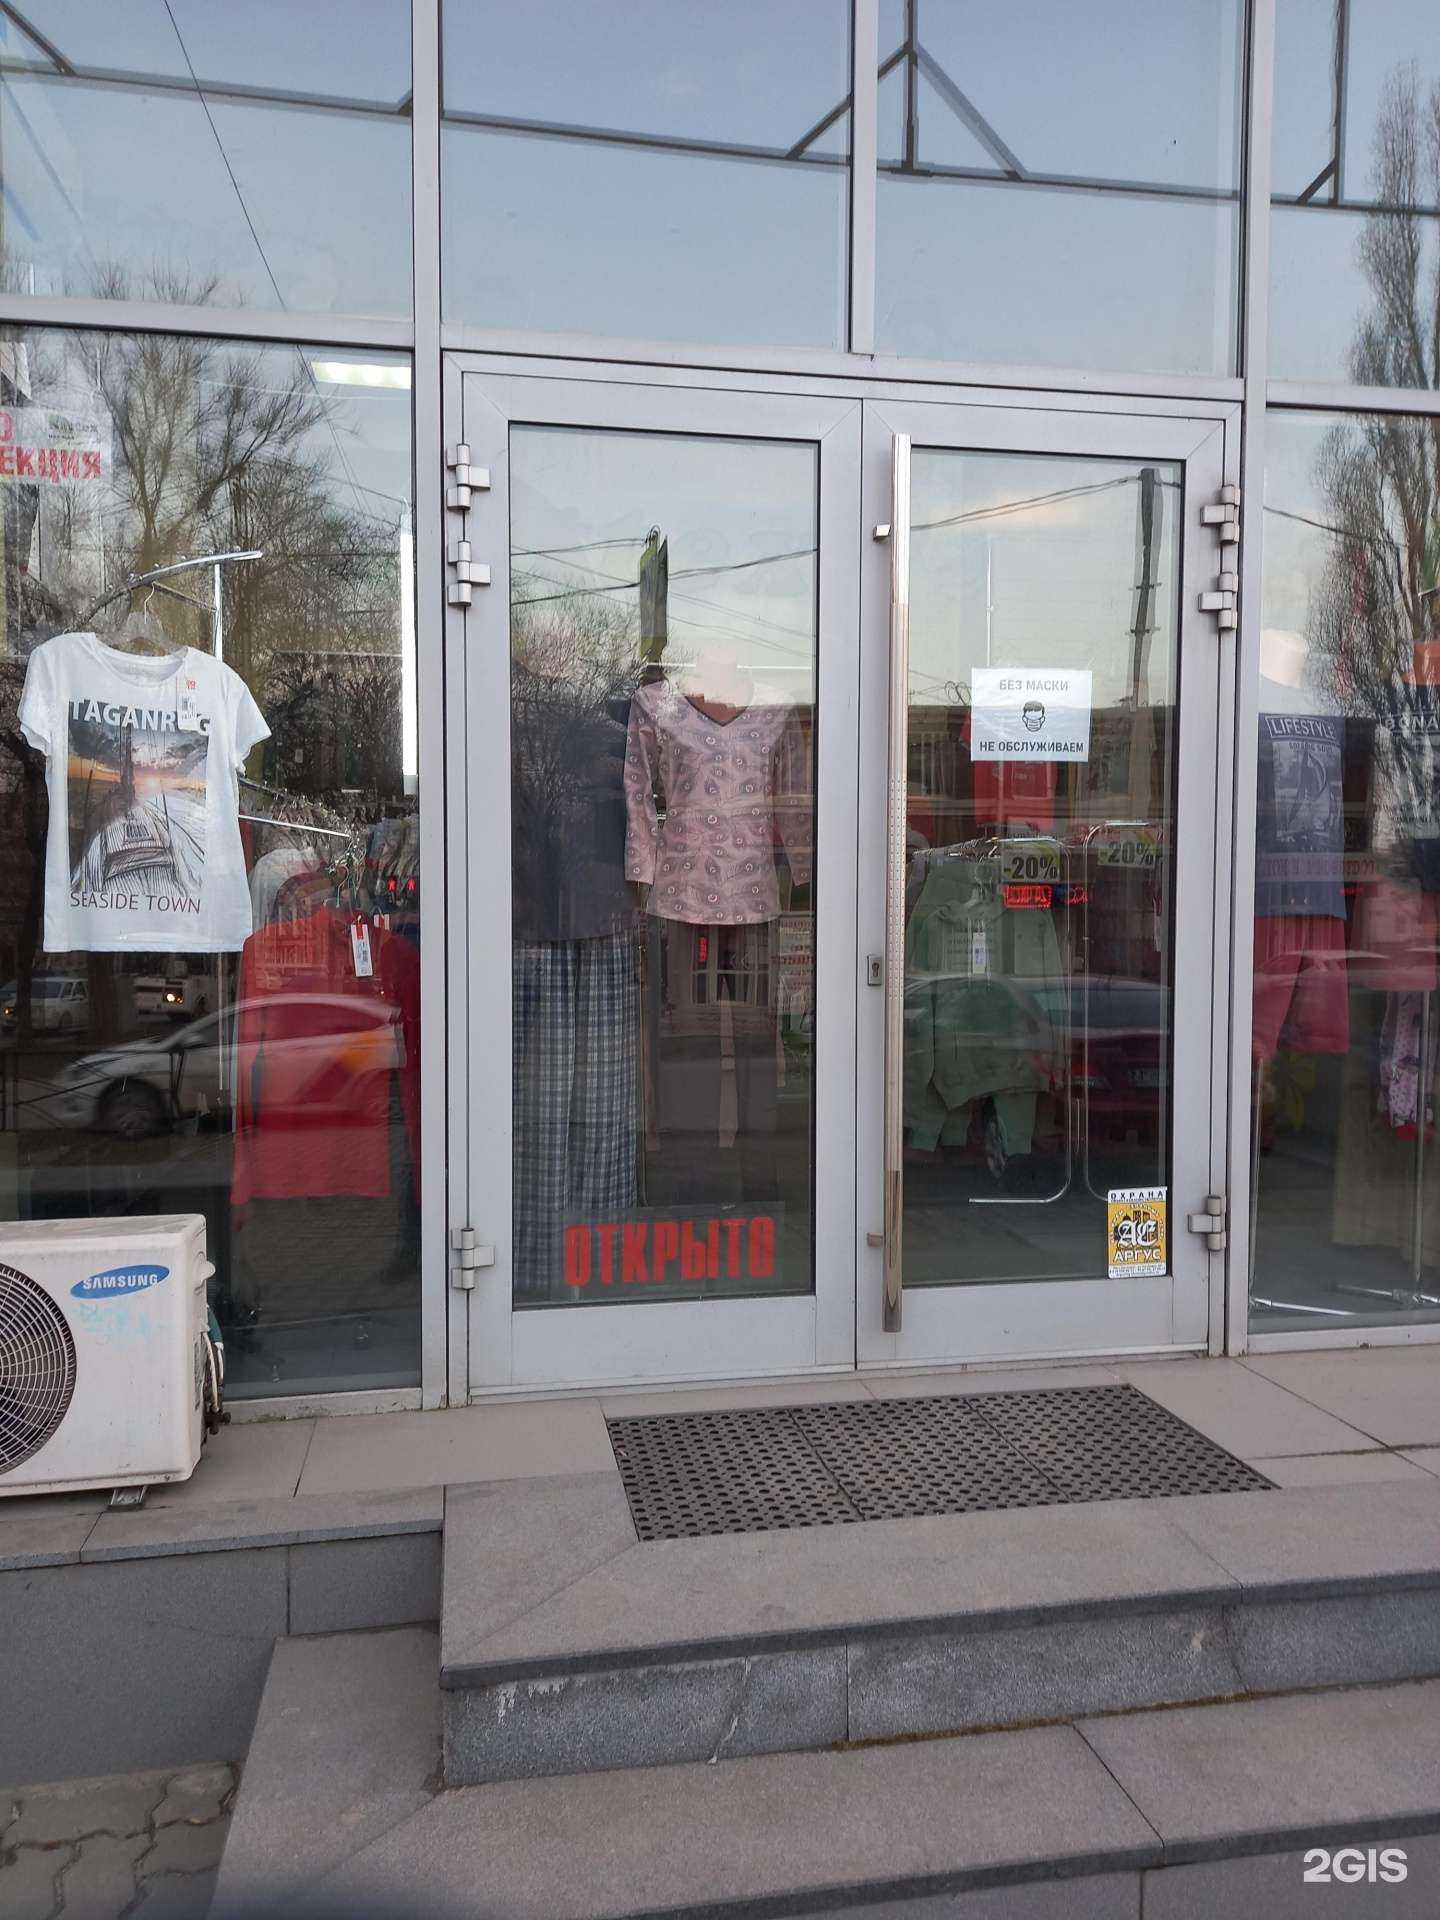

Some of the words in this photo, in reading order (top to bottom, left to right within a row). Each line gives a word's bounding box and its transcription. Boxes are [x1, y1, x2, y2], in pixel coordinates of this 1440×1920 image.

[1000, 680, 1022, 691] БЕЗ
[1026, 680, 1068, 691] МАСКИ
[69, 699, 211, 737] TAGANRG
[1271, 718, 1336, 740] LIFESTYLE
[979, 741, 995, 752] НЕ
[998, 741, 1084, 753] ОБСЛУЖИВАЕМ
[1003, 856, 1058, 880] -20%
[70, 893, 139, 911] SEASIDE
[145, 895, 201, 914] TOWN
[1110, 1190, 1164, 1200] ОХРАНА
[563, 1216, 776, 1287] ОТКРЫТО
[1113, 1249, 1161, 1262] АРГУС
[83, 1274, 158, 1290] SAMSUNG
